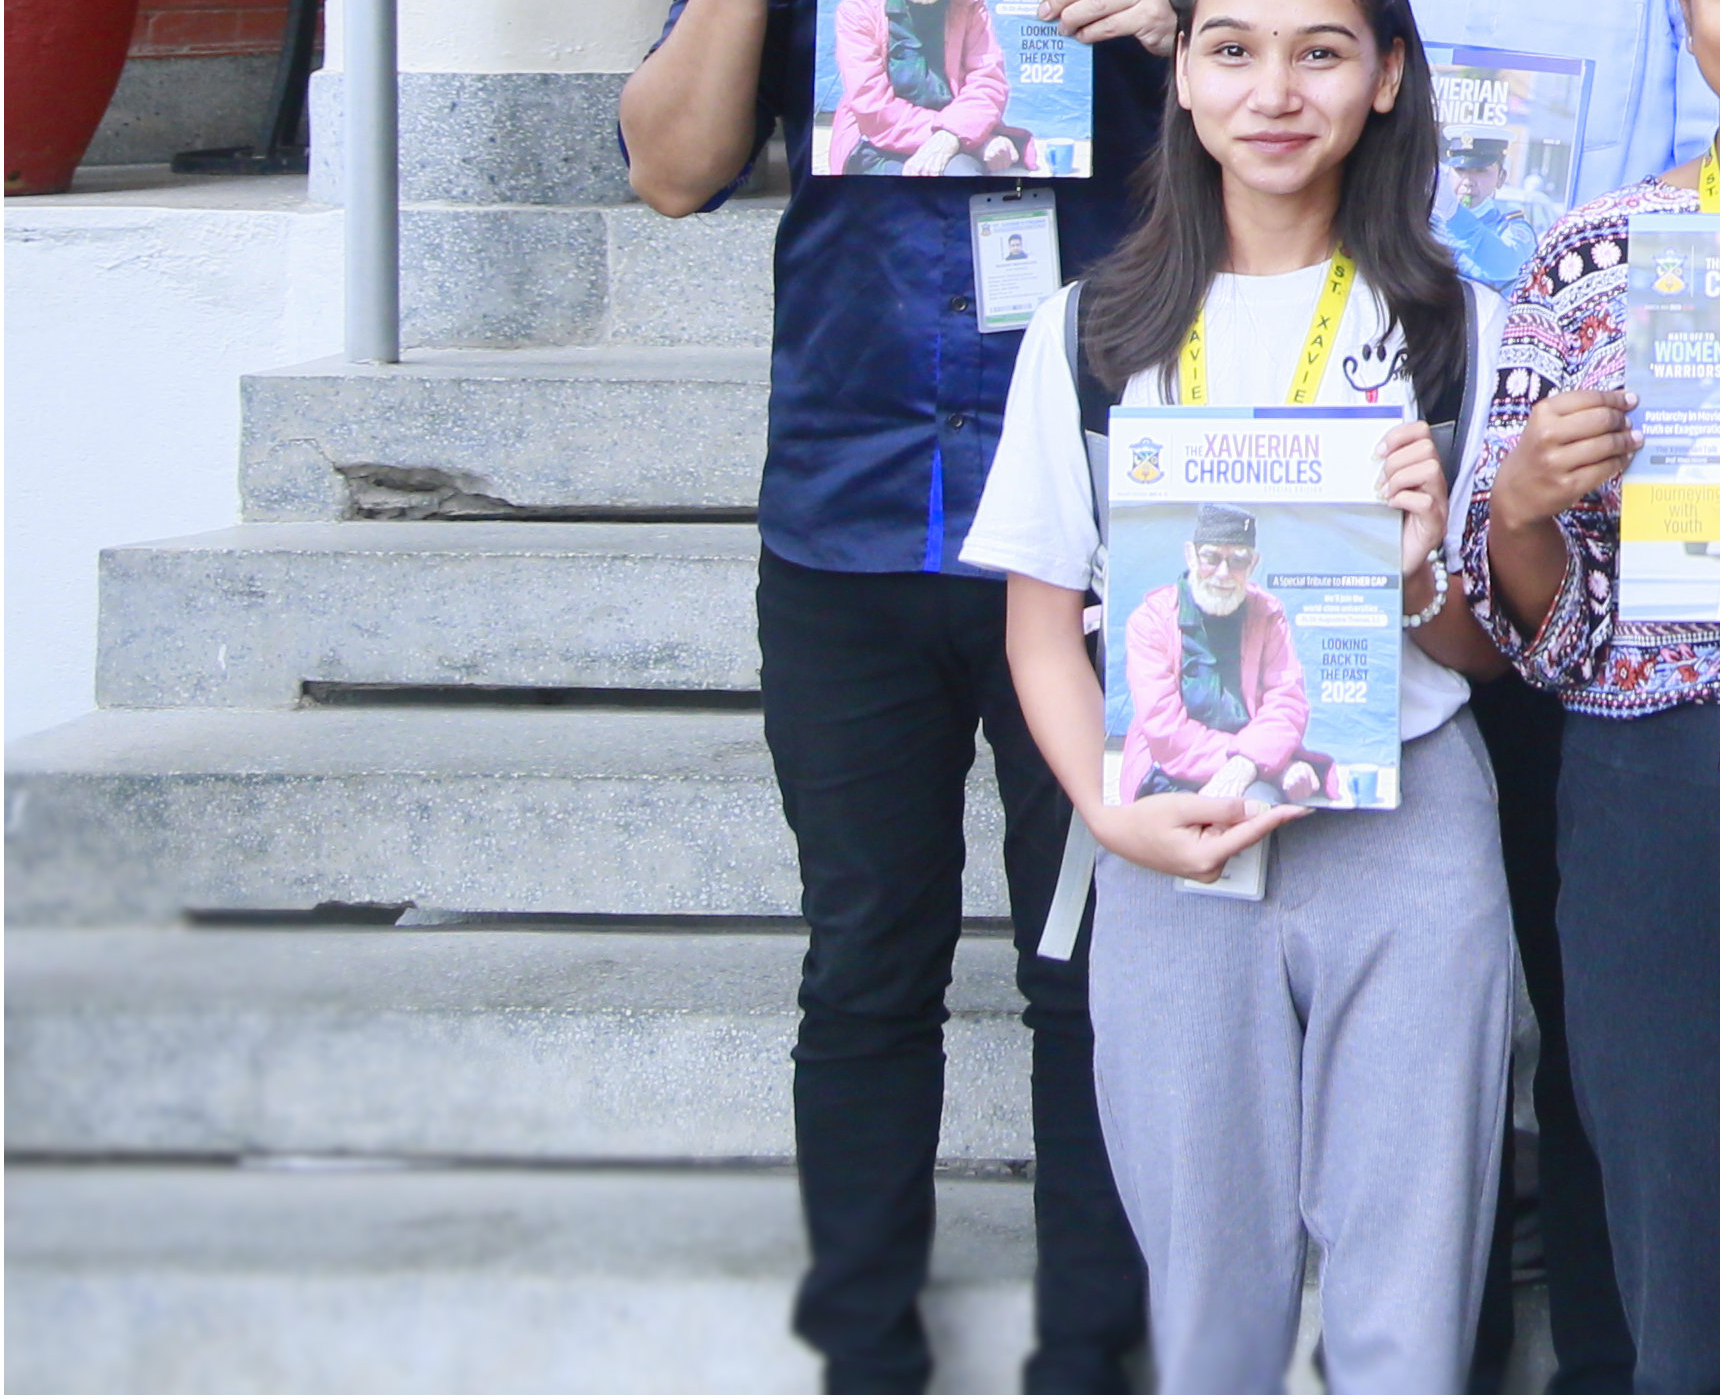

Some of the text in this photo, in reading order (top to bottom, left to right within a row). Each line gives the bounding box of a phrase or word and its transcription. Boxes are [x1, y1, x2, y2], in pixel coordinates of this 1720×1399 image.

[1022, 40, 1064, 50] BACK TO
[1020, 53, 1065, 64] THE PAST
[1020, 65, 1063, 84] 2022
[1293, 265, 1346, 403] ST. XAVIE
[1668, 333, 1687, 341] HATS
[1689, 333, 1703, 341] OFF
[1188, 315, 1202, 399] AVIE
[1645, 411, 1688, 423] Patriarchy
[1688, 411, 1696, 420] in
[1642, 424, 1664, 434] Truth
[1665, 425, 1673, 434] or
[1185, 434, 1321, 459] THE XAVIERIAN
[1185, 459, 1322, 485] CHRONICLES
[1668, 502, 1698, 519] with
[1663, 517, 1703, 534] Youth
[1273, 576, 1387, 587] A Special Tribute to FATHER CAP
[1322, 638, 1368, 651] LOOKING
[1323, 653, 1367, 666] BACK TO
[1321, 669, 1368, 680] THE PAST
[1321, 681, 1367, 703] 2022
